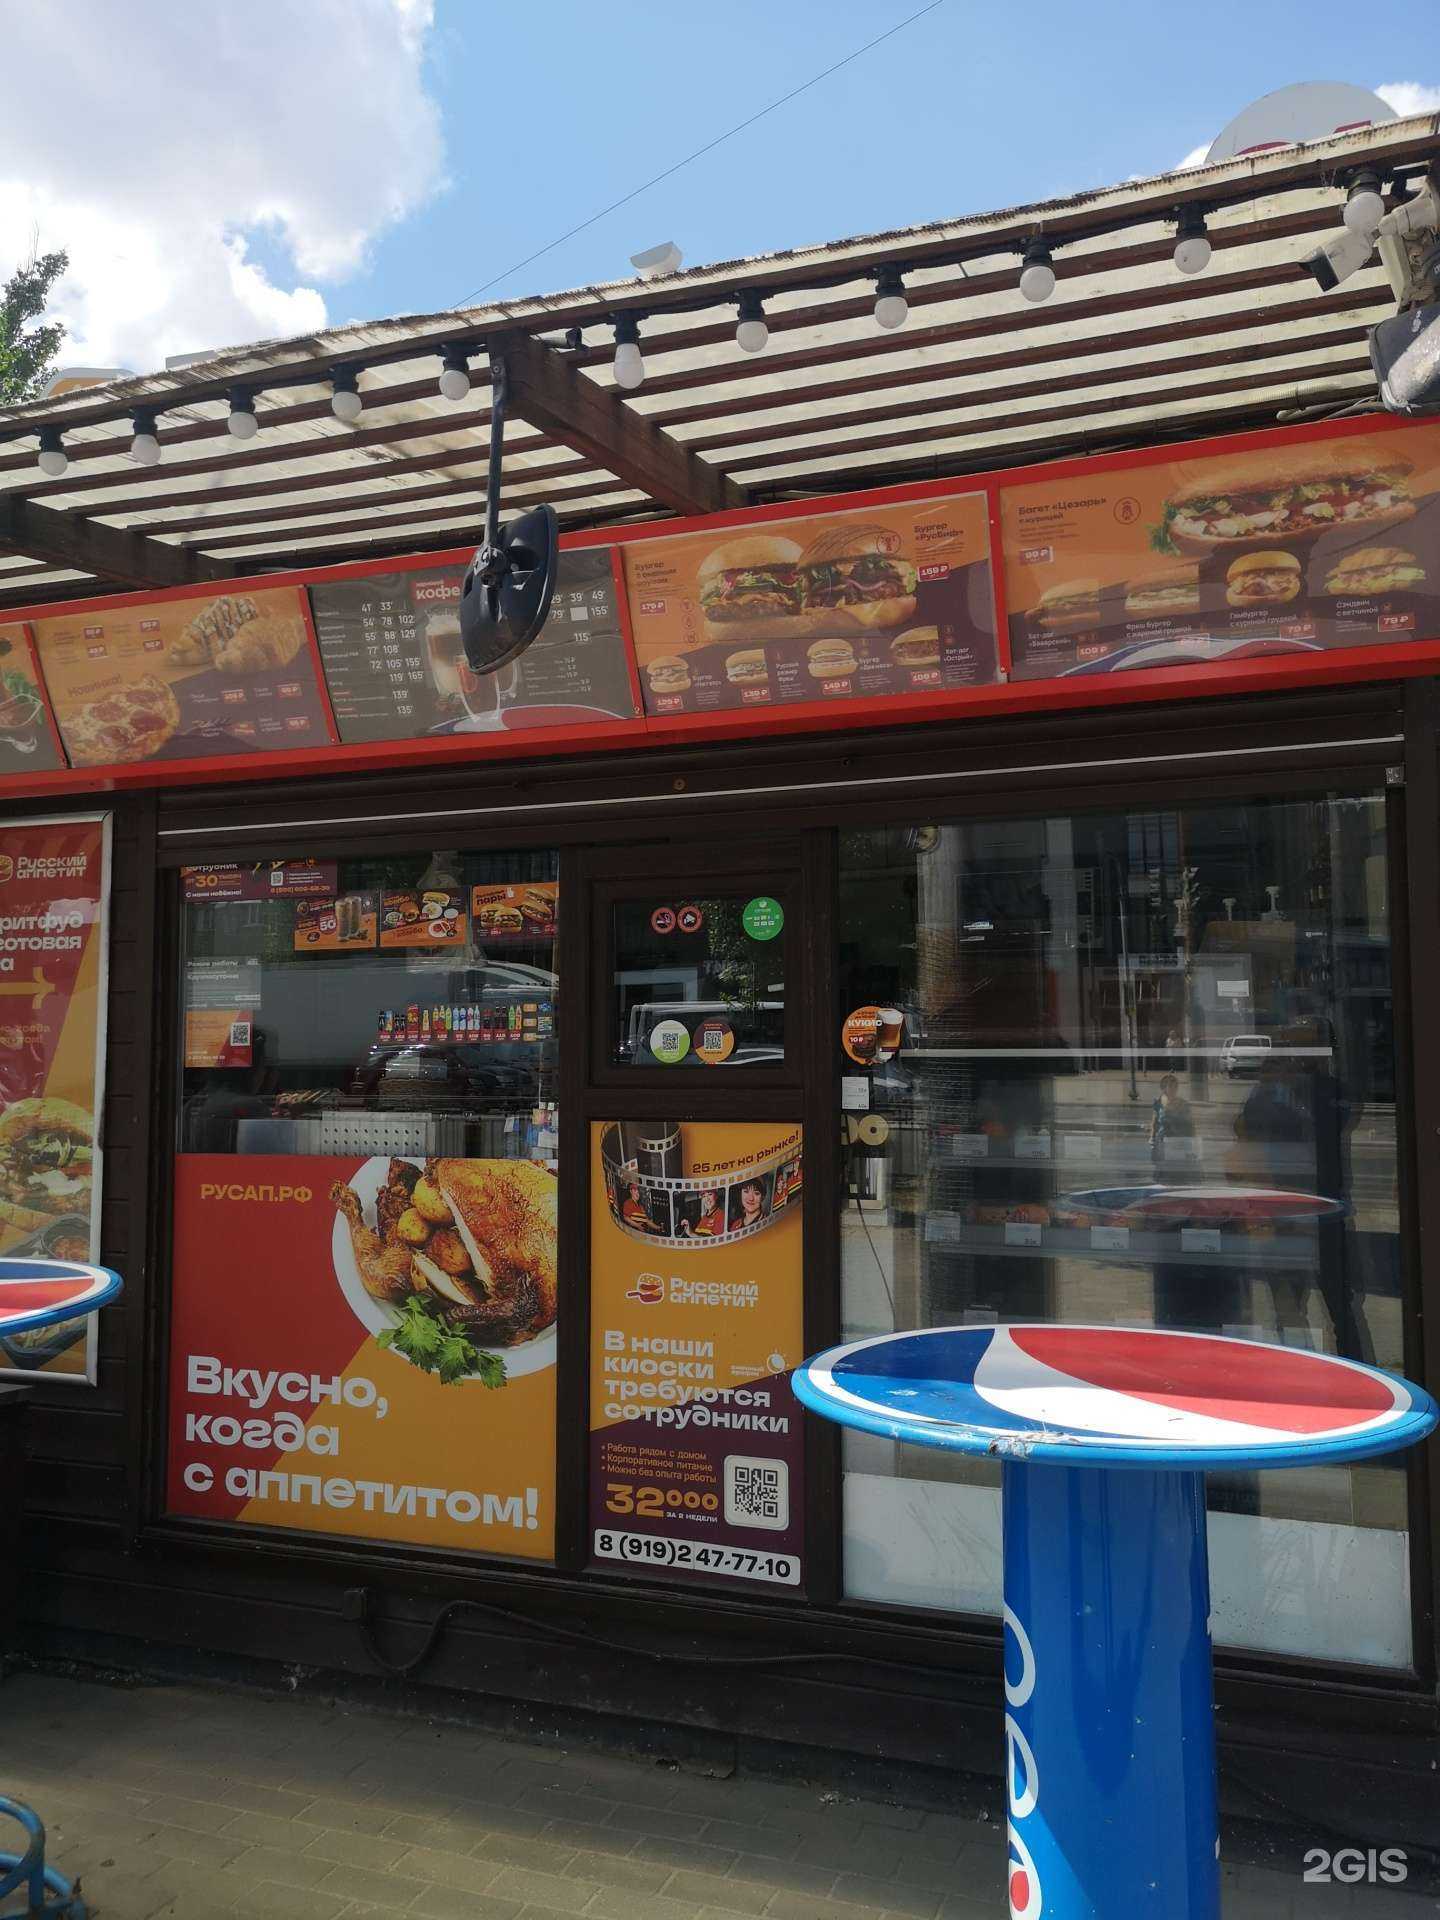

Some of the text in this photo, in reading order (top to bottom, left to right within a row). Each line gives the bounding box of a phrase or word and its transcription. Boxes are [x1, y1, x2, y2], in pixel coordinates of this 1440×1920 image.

[416, 584, 461, 600] кофе
[17, 852, 87, 869] Русский
[16, 867, 88, 880] аппетит
[195, 873, 219, 888] 30
[692, 1129, 800, 1174] 25 лет на рынке!
[200, 1183, 313, 1204] РУСАП.РФ
[670, 1277, 759, 1297] Русский
[670, 1293, 759, 1309] аппетит
[604, 1330, 715, 1359] В наши
[604, 1356, 715, 1380] киоски
[186, 1354, 390, 1420] Вкусно,
[603, 1378, 771, 1408] требуются
[603, 1402, 790, 1435] сотрудники
[185, 1411, 340, 1457] когда
[607, 1442, 637, 1455] Работа
[639, 1446, 667, 1458] рядом
[677, 1450, 707, 1461] домом
[607, 1453, 713, 1473] Корпоративное питание
[607, 1463, 717, 1484] Можно без опыта работы
[183, 1461, 539, 1532] с аппетитом!
[606, 1482, 719, 1518] 32000
[599, 1534, 613, 1553] 8
